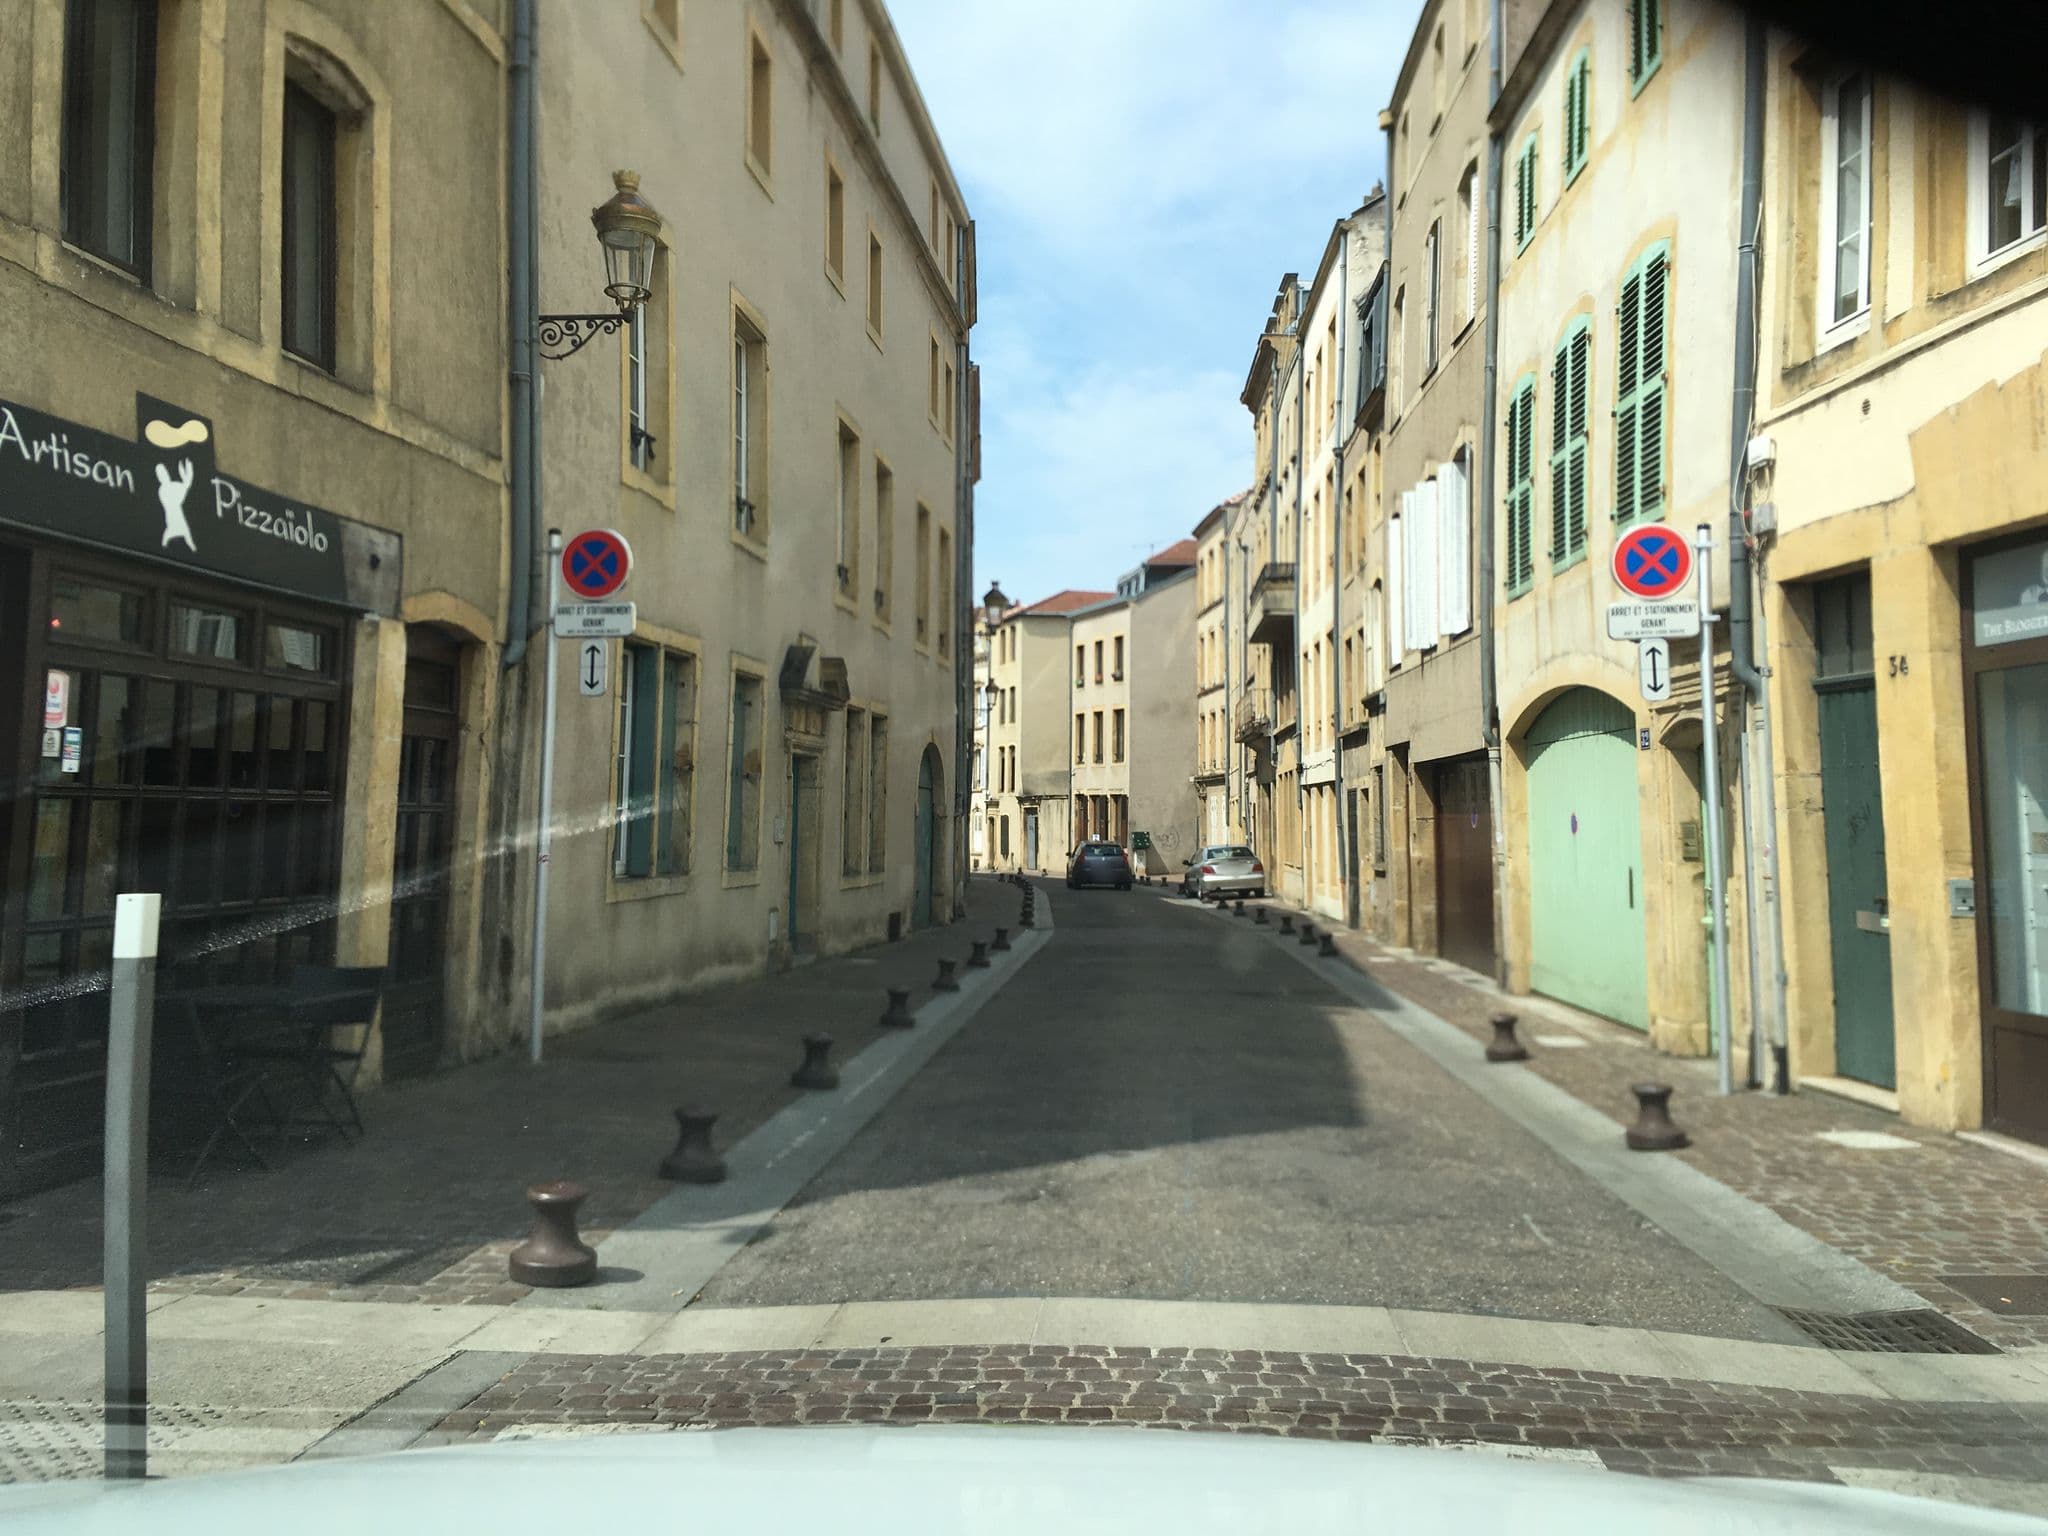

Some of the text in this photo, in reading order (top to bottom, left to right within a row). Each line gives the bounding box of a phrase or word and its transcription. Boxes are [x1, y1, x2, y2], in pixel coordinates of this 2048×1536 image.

[0, 407, 328, 552] Artisan Pizzaïolo
[1611, 603, 1697, 618] ARRET ET STATIONNEMENT
